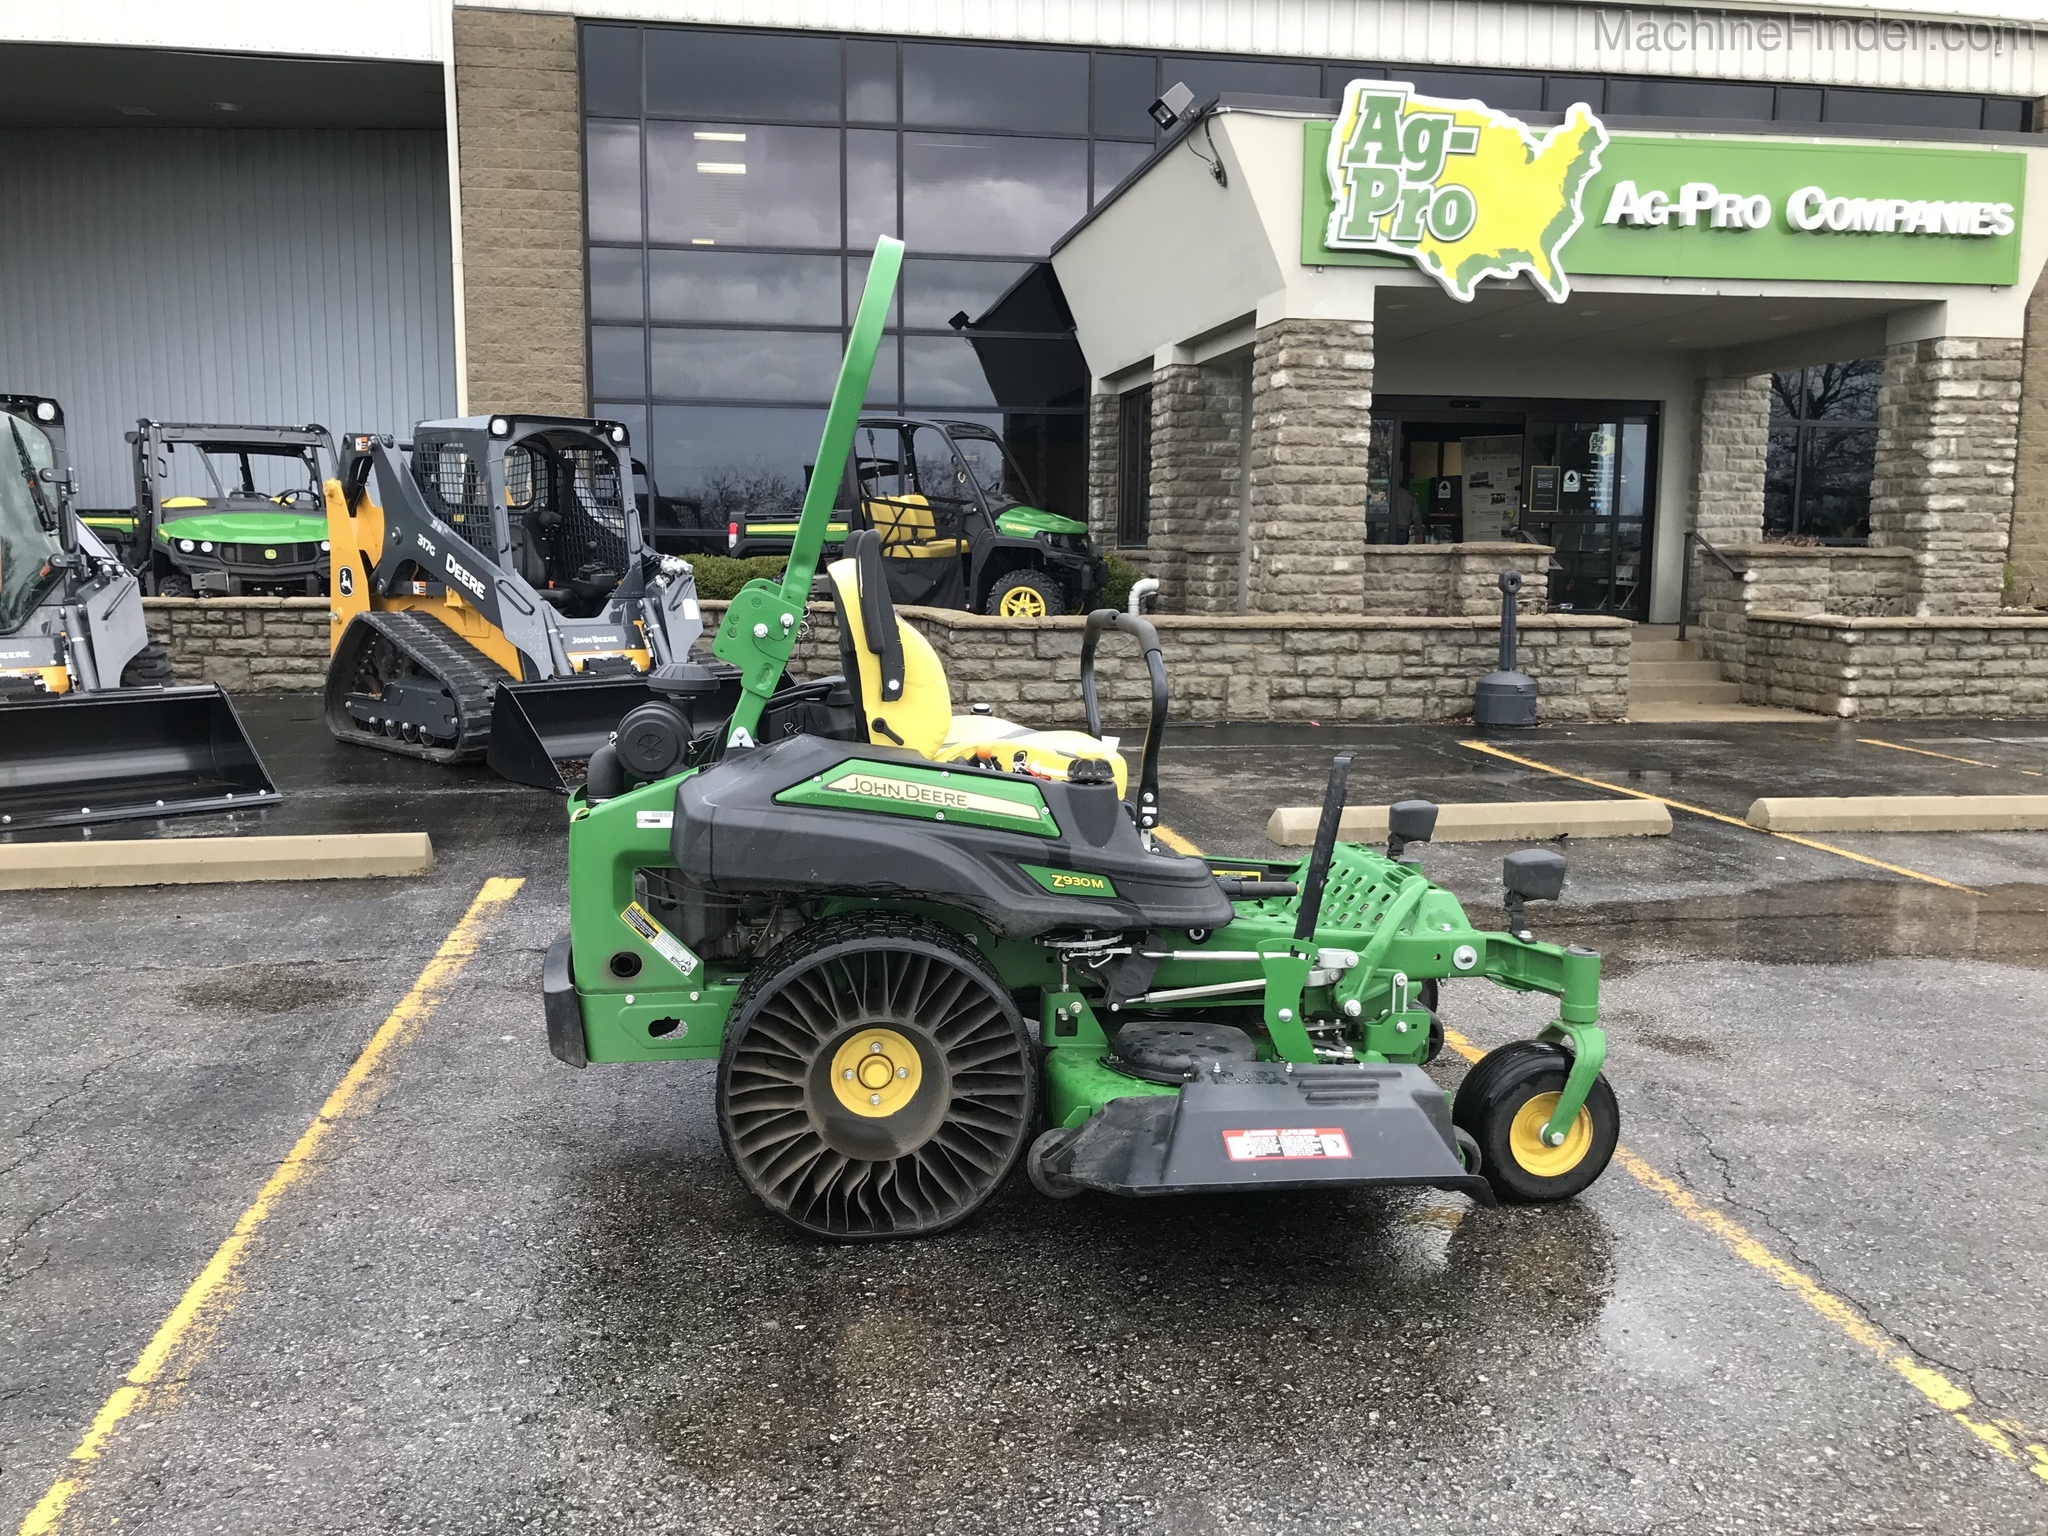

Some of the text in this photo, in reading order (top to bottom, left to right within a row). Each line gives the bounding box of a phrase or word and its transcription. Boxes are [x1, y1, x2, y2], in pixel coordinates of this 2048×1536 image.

[1342, 88, 1479, 183] Ag-
[1339, 166, 1477, 243] Pro
[416, 533, 436, 557] 317G
[445, 552, 486, 601] DEERE
[508, 628, 542, 641] 9254
[571, 635, 618, 644] JOHN DEERE
[845, 775, 968, 808] JOHN DEERE
[1049, 873, 1104, 889] Z930M
